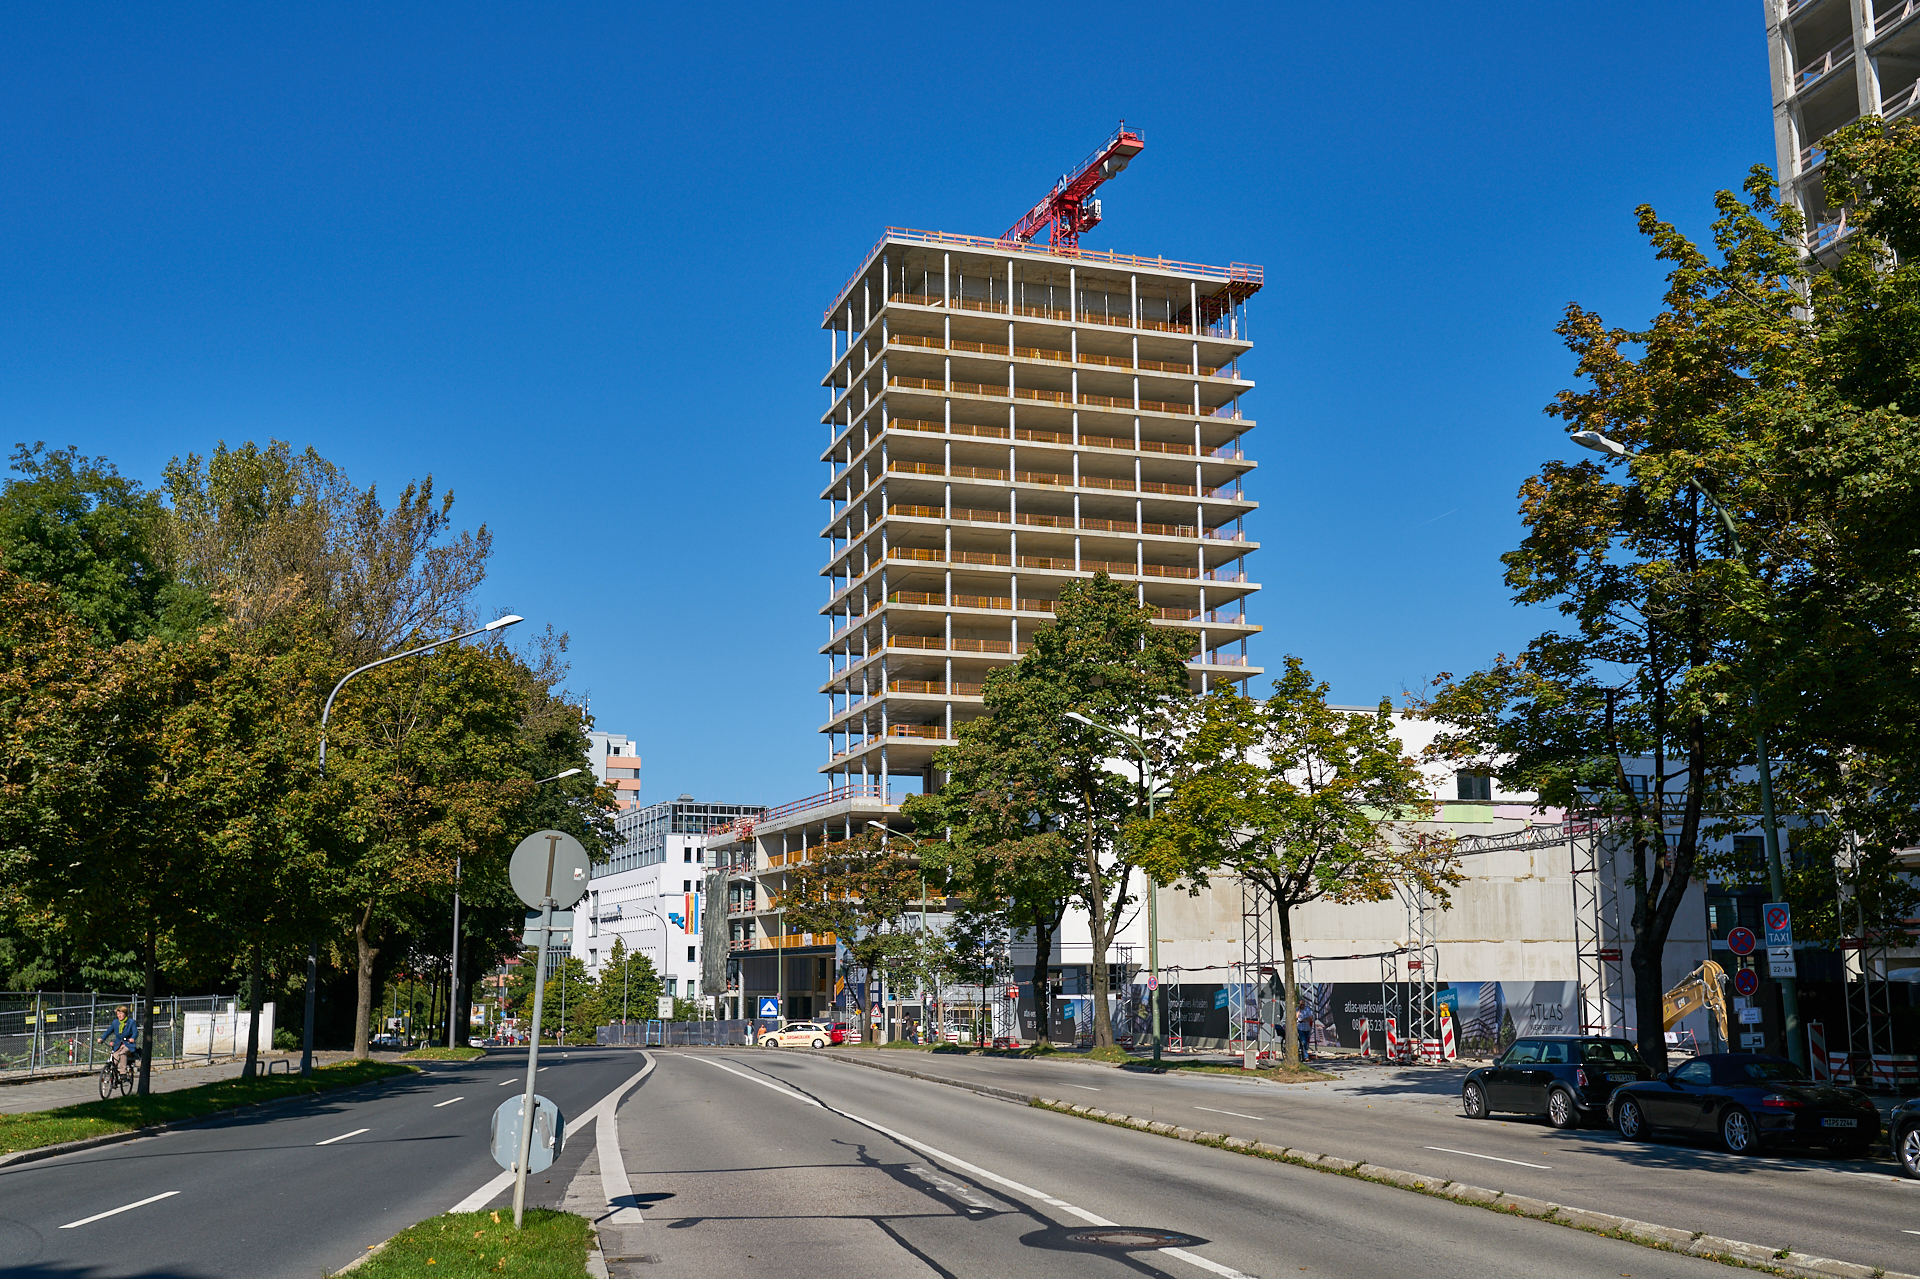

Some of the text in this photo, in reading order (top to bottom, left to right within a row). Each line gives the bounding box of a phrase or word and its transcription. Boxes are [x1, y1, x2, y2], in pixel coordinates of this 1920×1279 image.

[1768, 933, 1790, 943] TAXI
[1529, 1003, 1564, 1021] ATLAS
[1531, 1024, 1563, 1032] WERKSVIERTEL
